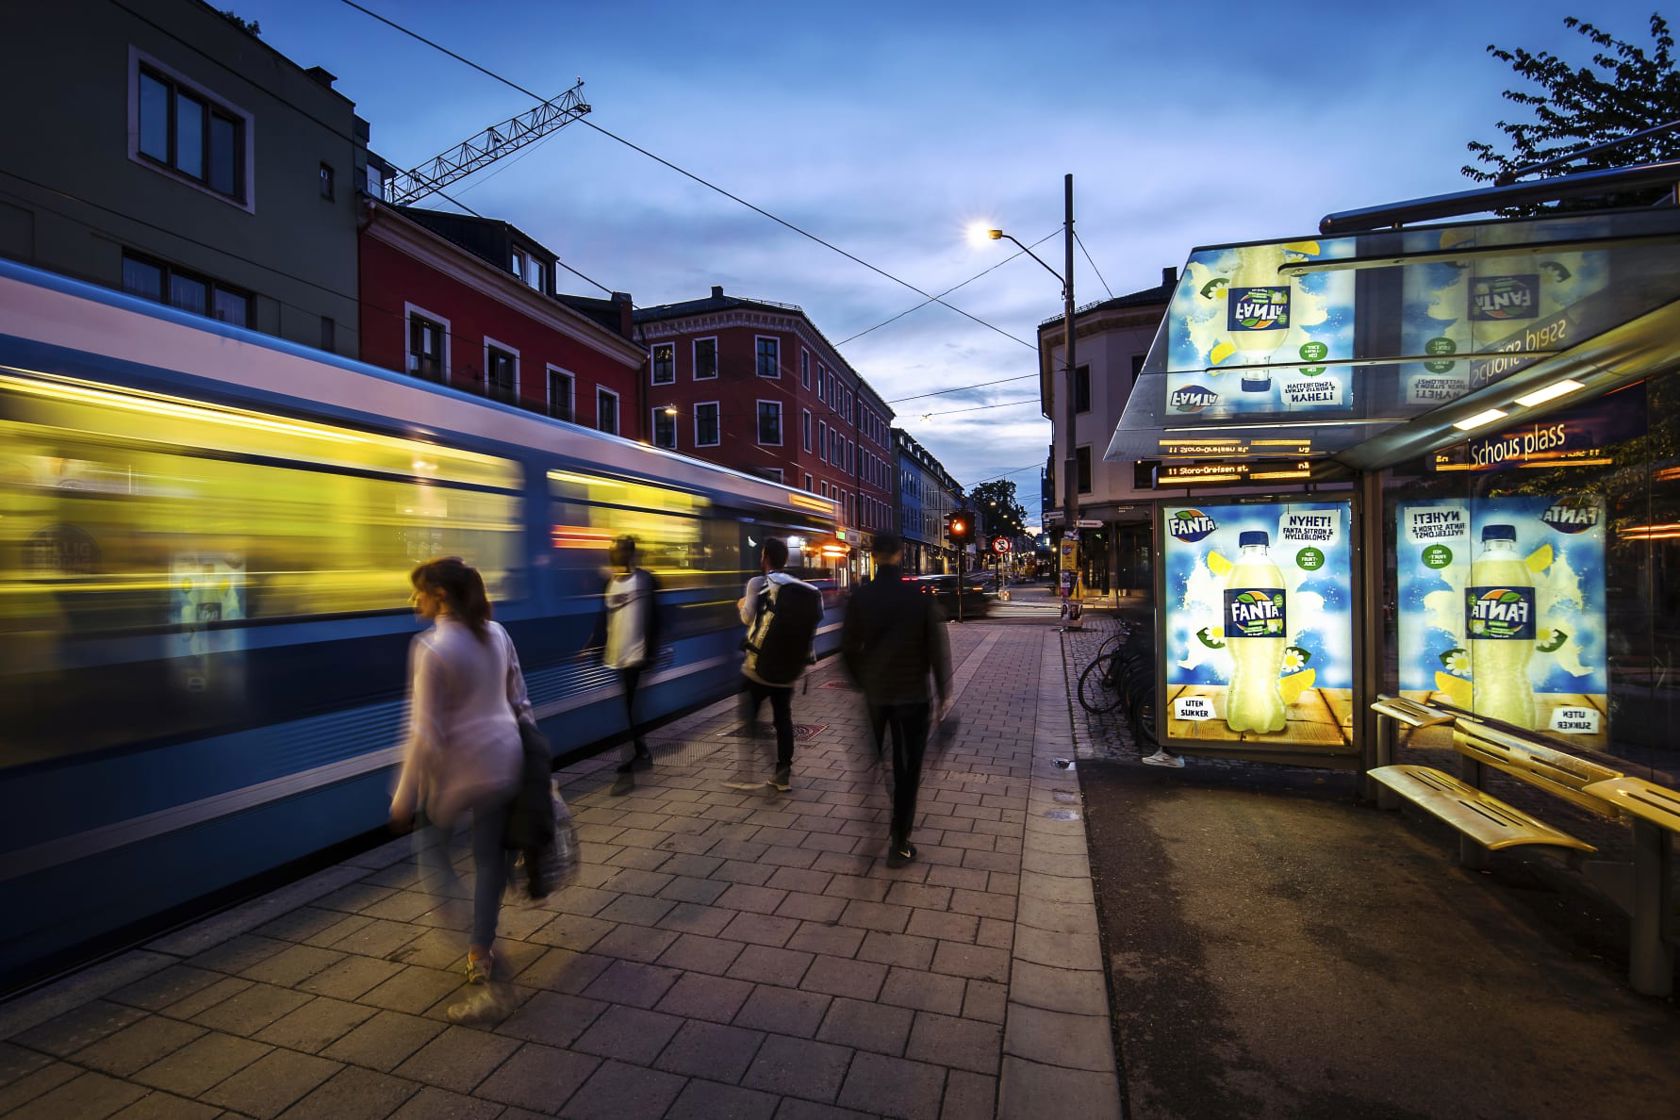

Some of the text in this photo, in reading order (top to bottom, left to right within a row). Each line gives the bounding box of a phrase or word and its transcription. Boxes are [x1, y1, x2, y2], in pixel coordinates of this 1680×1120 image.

[1474, 289, 1531, 311] FANTA
[1471, 424, 1565, 467] Schous plass
[1170, 516, 1215, 535] FANTA
[1290, 516, 1331, 527] NYHET!
[1231, 601, 1279, 621] FANTA
